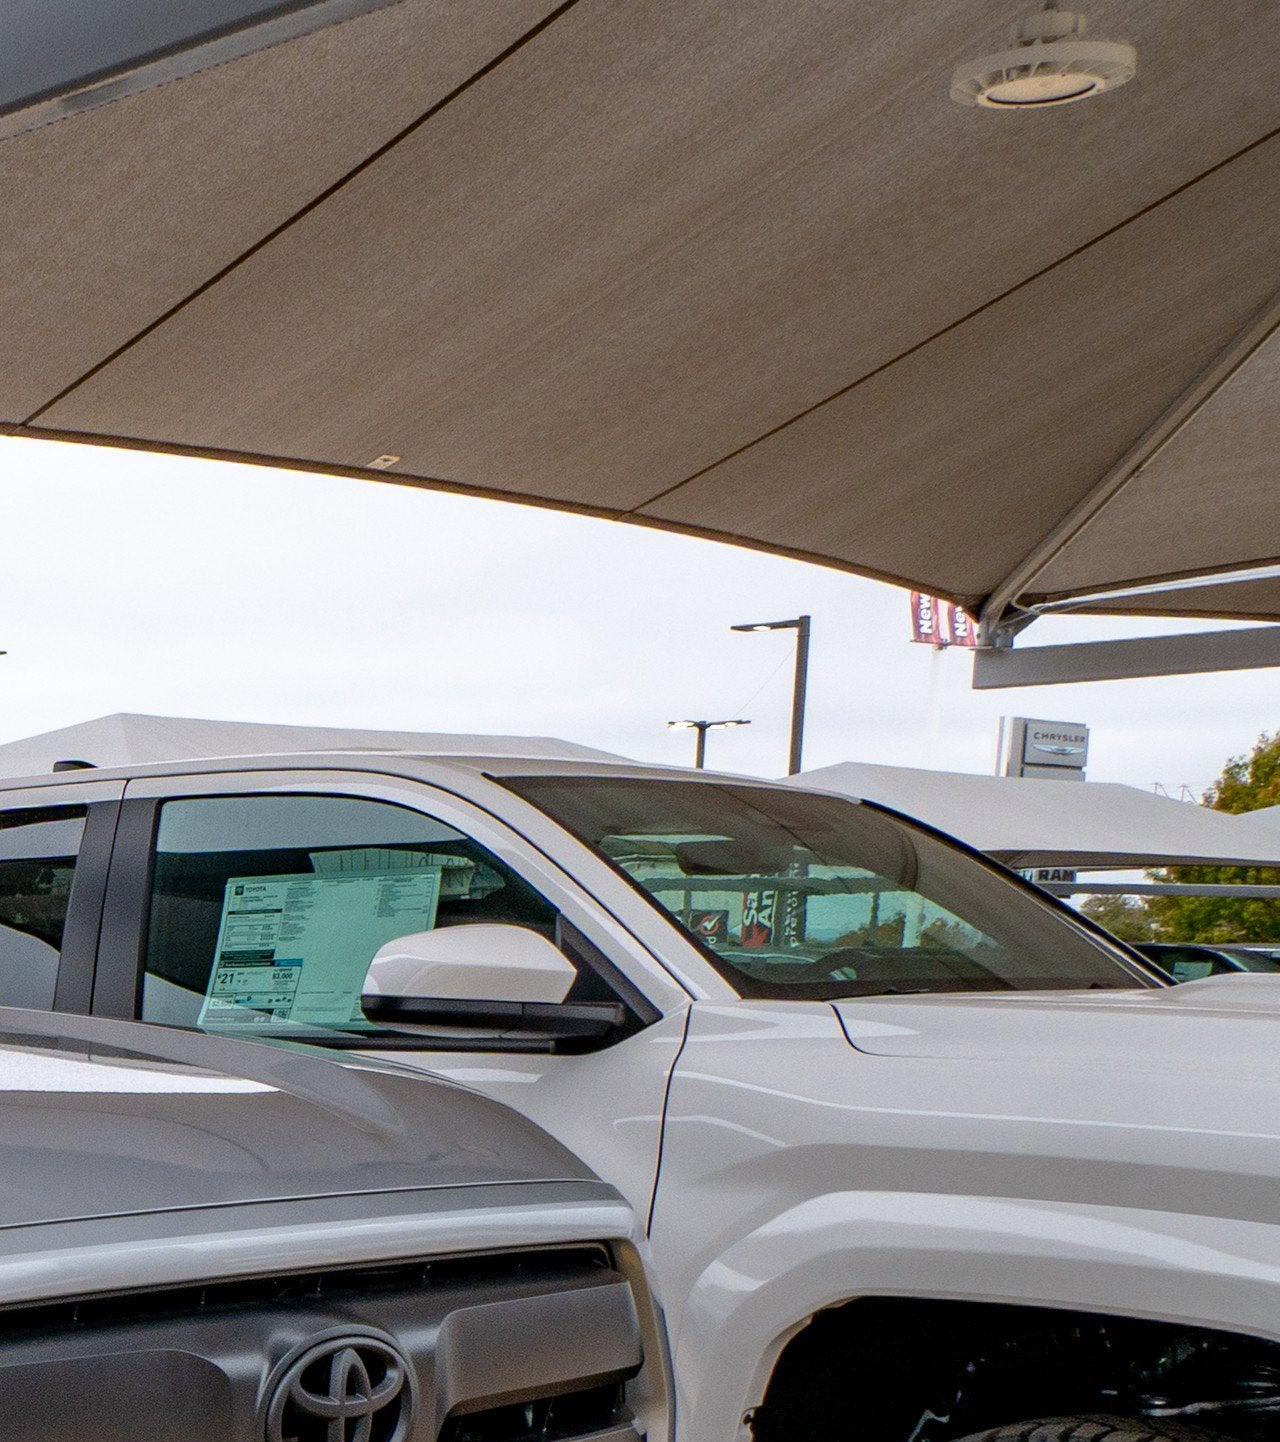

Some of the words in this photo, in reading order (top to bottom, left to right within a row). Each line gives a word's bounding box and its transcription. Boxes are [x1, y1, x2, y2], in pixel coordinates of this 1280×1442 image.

[1033, 731, 1086, 743] CHRYSLER
[1038, 869, 1074, 881] RAM
[742, 890, 758, 927] Sa
